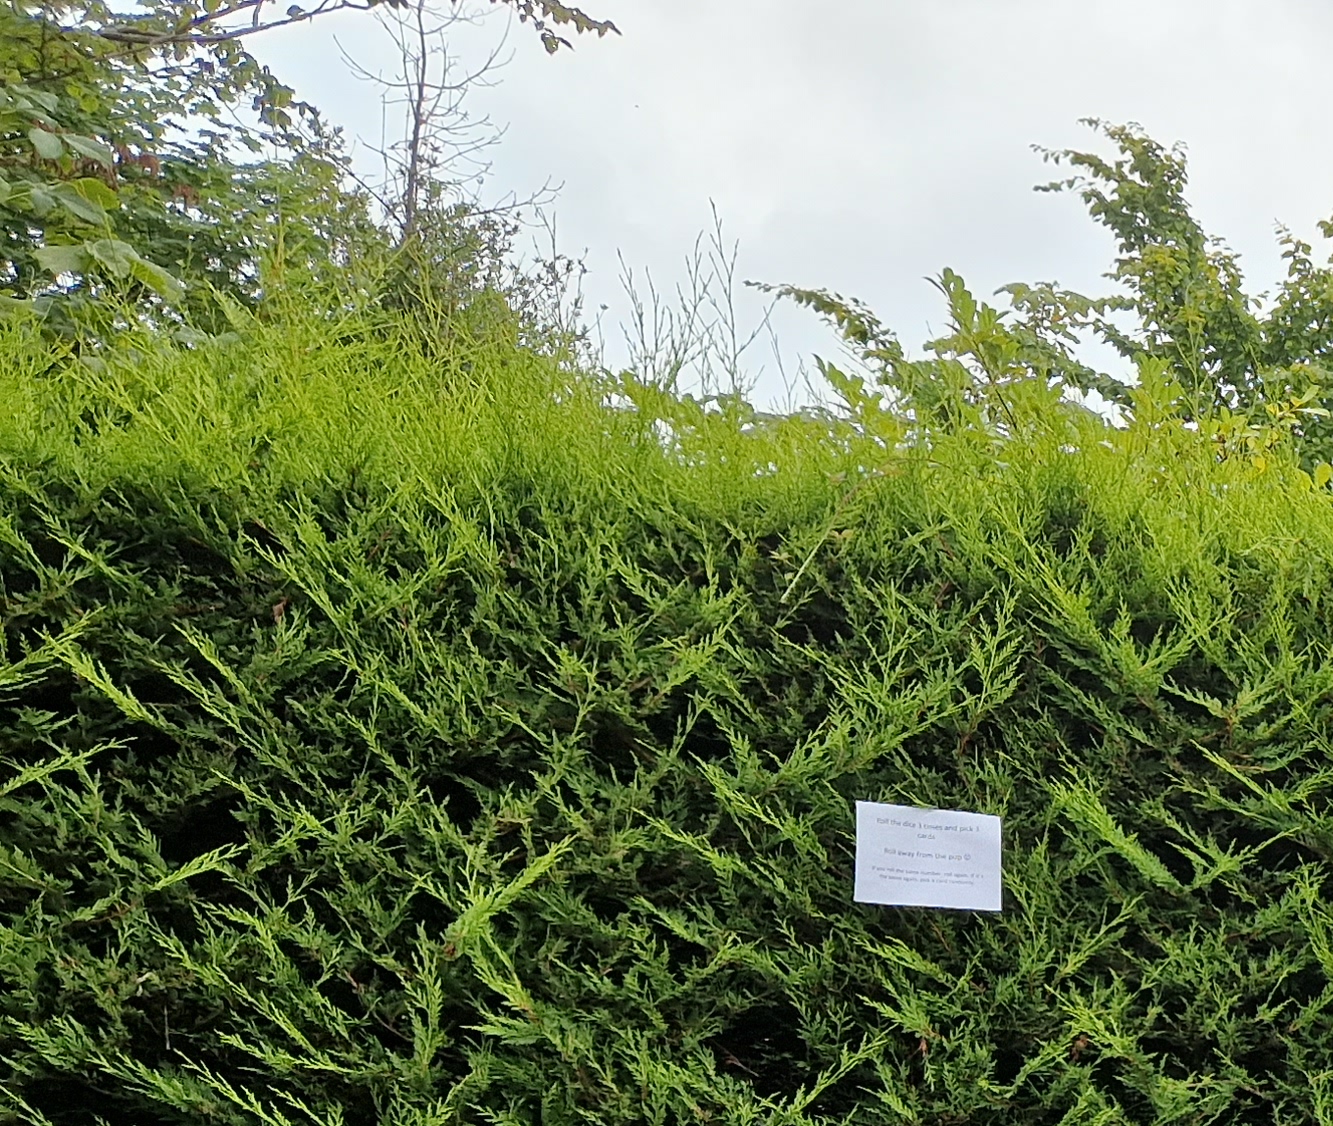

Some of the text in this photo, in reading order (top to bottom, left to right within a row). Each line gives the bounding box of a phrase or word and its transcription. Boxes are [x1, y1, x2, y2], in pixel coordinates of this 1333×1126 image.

[898, 850, 915, 858] away
[916, 851, 933, 859] from
[935, 853, 947, 861] the
[949, 854, 962, 862] pup
